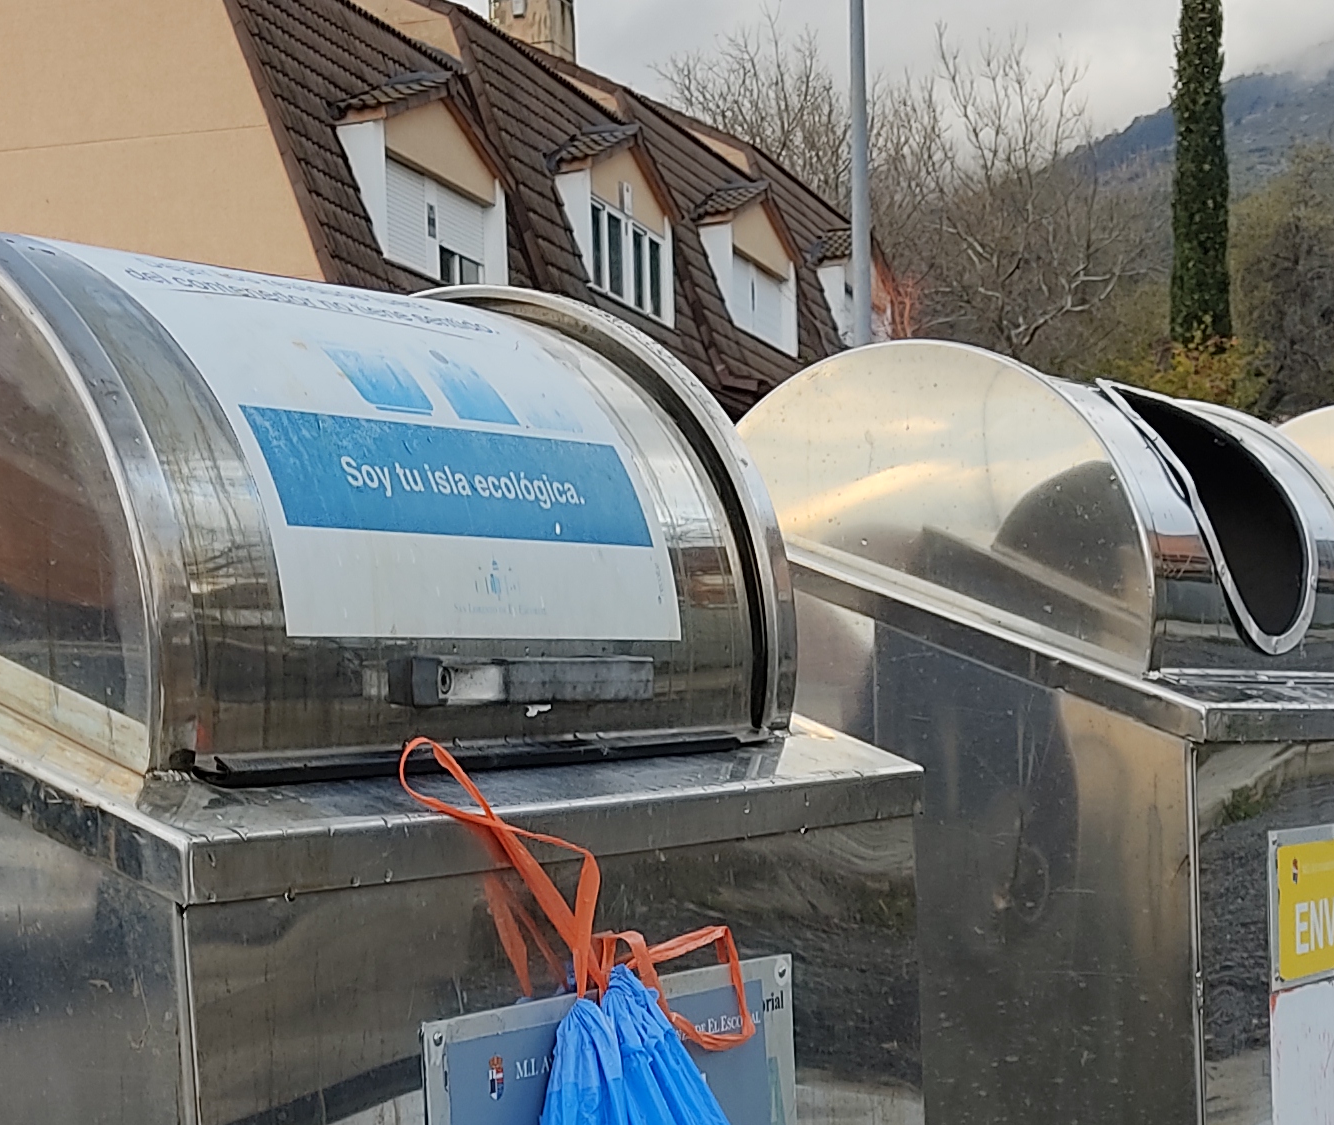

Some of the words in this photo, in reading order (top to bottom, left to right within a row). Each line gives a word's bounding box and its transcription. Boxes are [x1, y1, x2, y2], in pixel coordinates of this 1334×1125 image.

[124, 266, 173, 285] del
[171, 276, 316, 308] contenedor
[316, 299, 354, 313] no
[340, 455, 393, 498] Soy
[394, 461, 425, 493] tu
[423, 463, 473, 496] isla
[473, 470, 586, 510] ecológica.
[707, 1017, 720, 1034] EL
